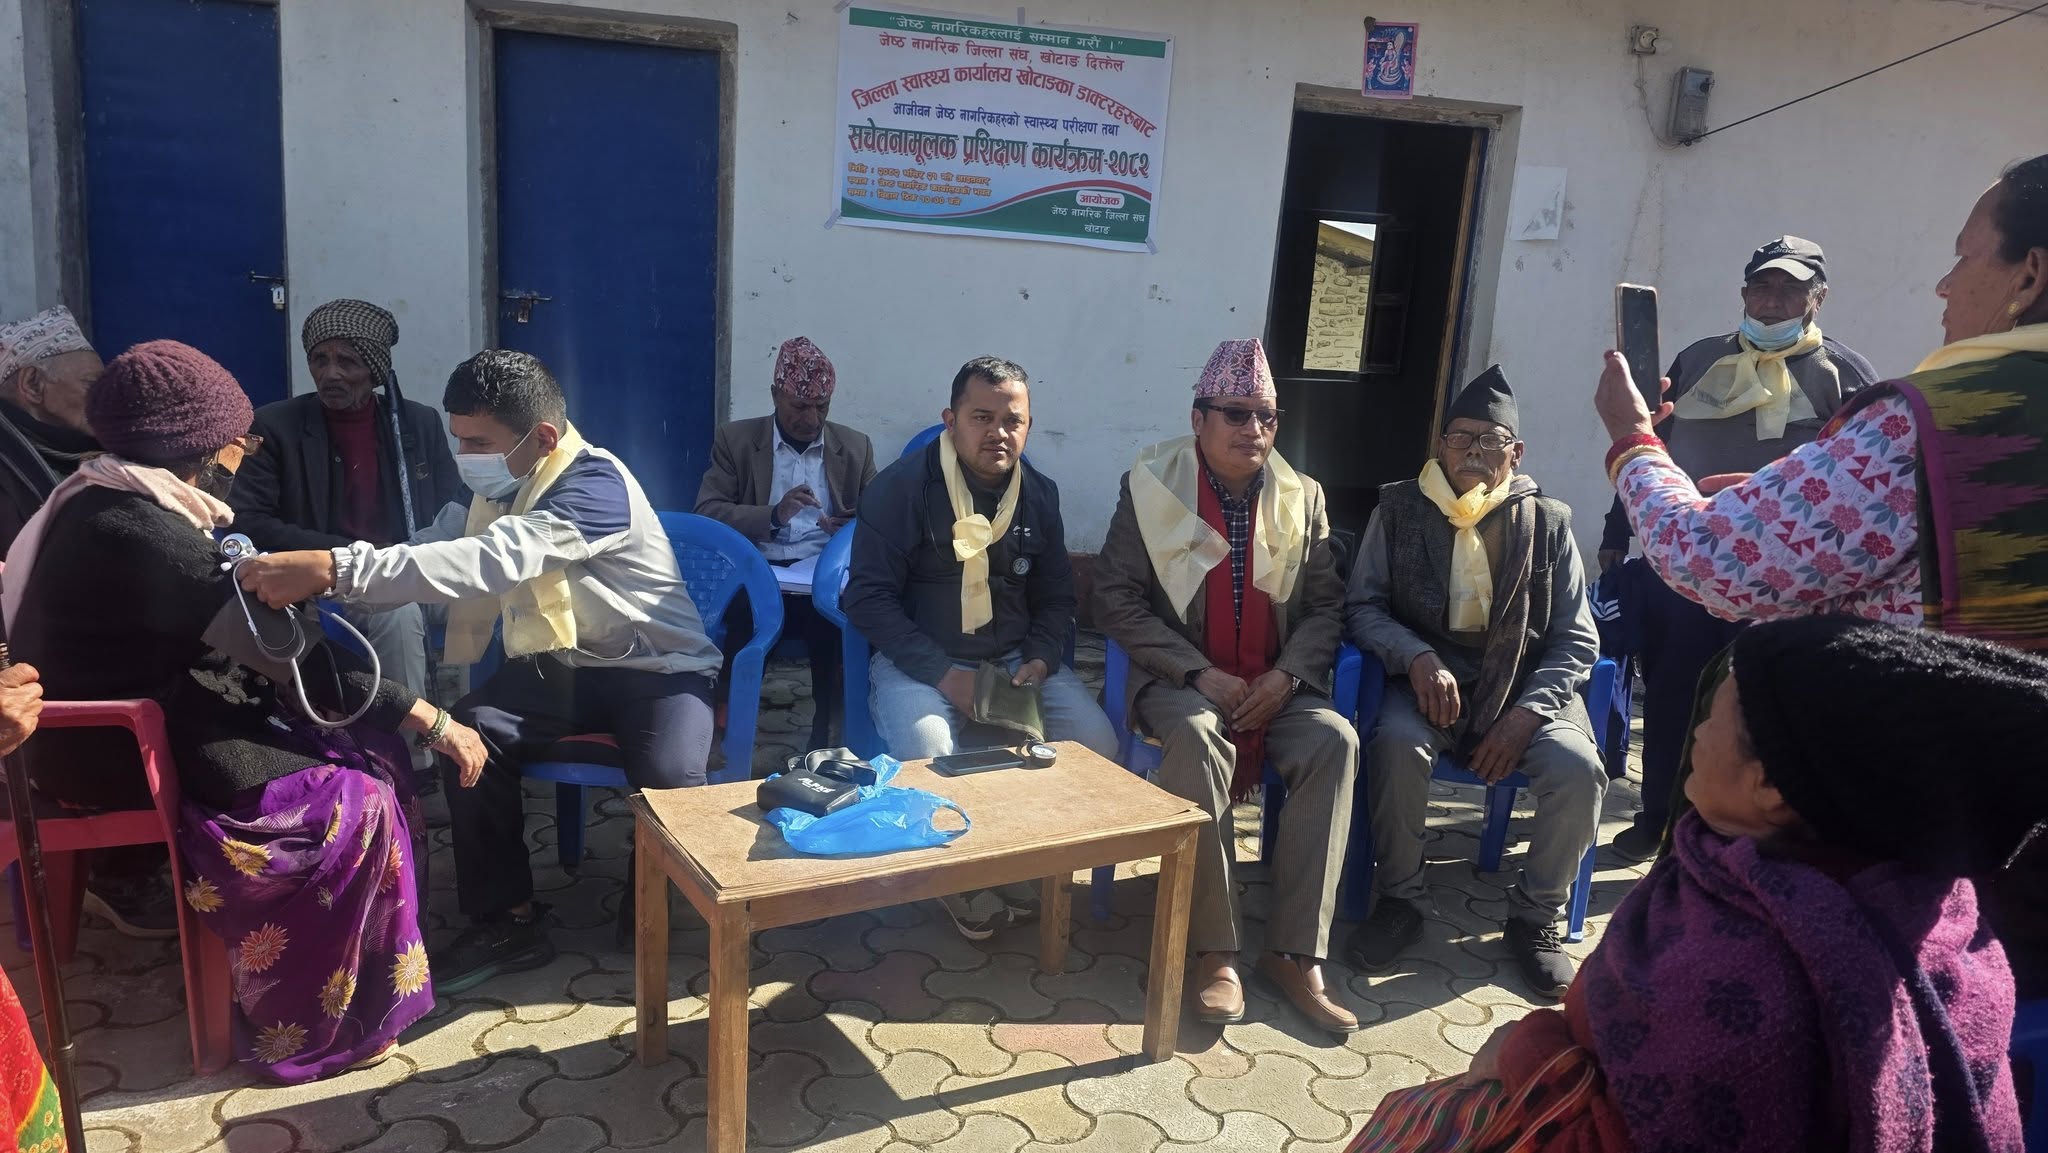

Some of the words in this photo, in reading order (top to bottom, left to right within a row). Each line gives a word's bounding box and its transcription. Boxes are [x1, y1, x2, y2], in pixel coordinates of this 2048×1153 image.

[879, 32, 906, 48] जेष्ठ
[911, 36, 960, 55] नागरिक
[965, 40, 1004, 59] जिल्ला
[1040, 49, 1080, 68] खोटाङ
[1029, 32, 1071, 46] सम्मान
[851, 80, 899, 110] जिल्ला
[900, 68, 951, 93] स्वास्थ्य
[954, 62, 1013, 83] कार्यालय
[893, 101, 931, 118] आजीवन
[935, 104, 956, 120] जेष्ठ
[1062, 116, 1098, 135] परीक्षण
[1101, 123, 1120, 137] तथा
[848, 117, 959, 166] सचेतनामूलक
[962, 127, 1028, 169] प्रशिक्षण
[1051, 204, 1069, 216] जेष्ठ
[1071, 207, 1103, 220] नागरिक
[1105, 208, 1130, 222] जिल्ला
[1079, 194, 1120, 206] आयोजक
